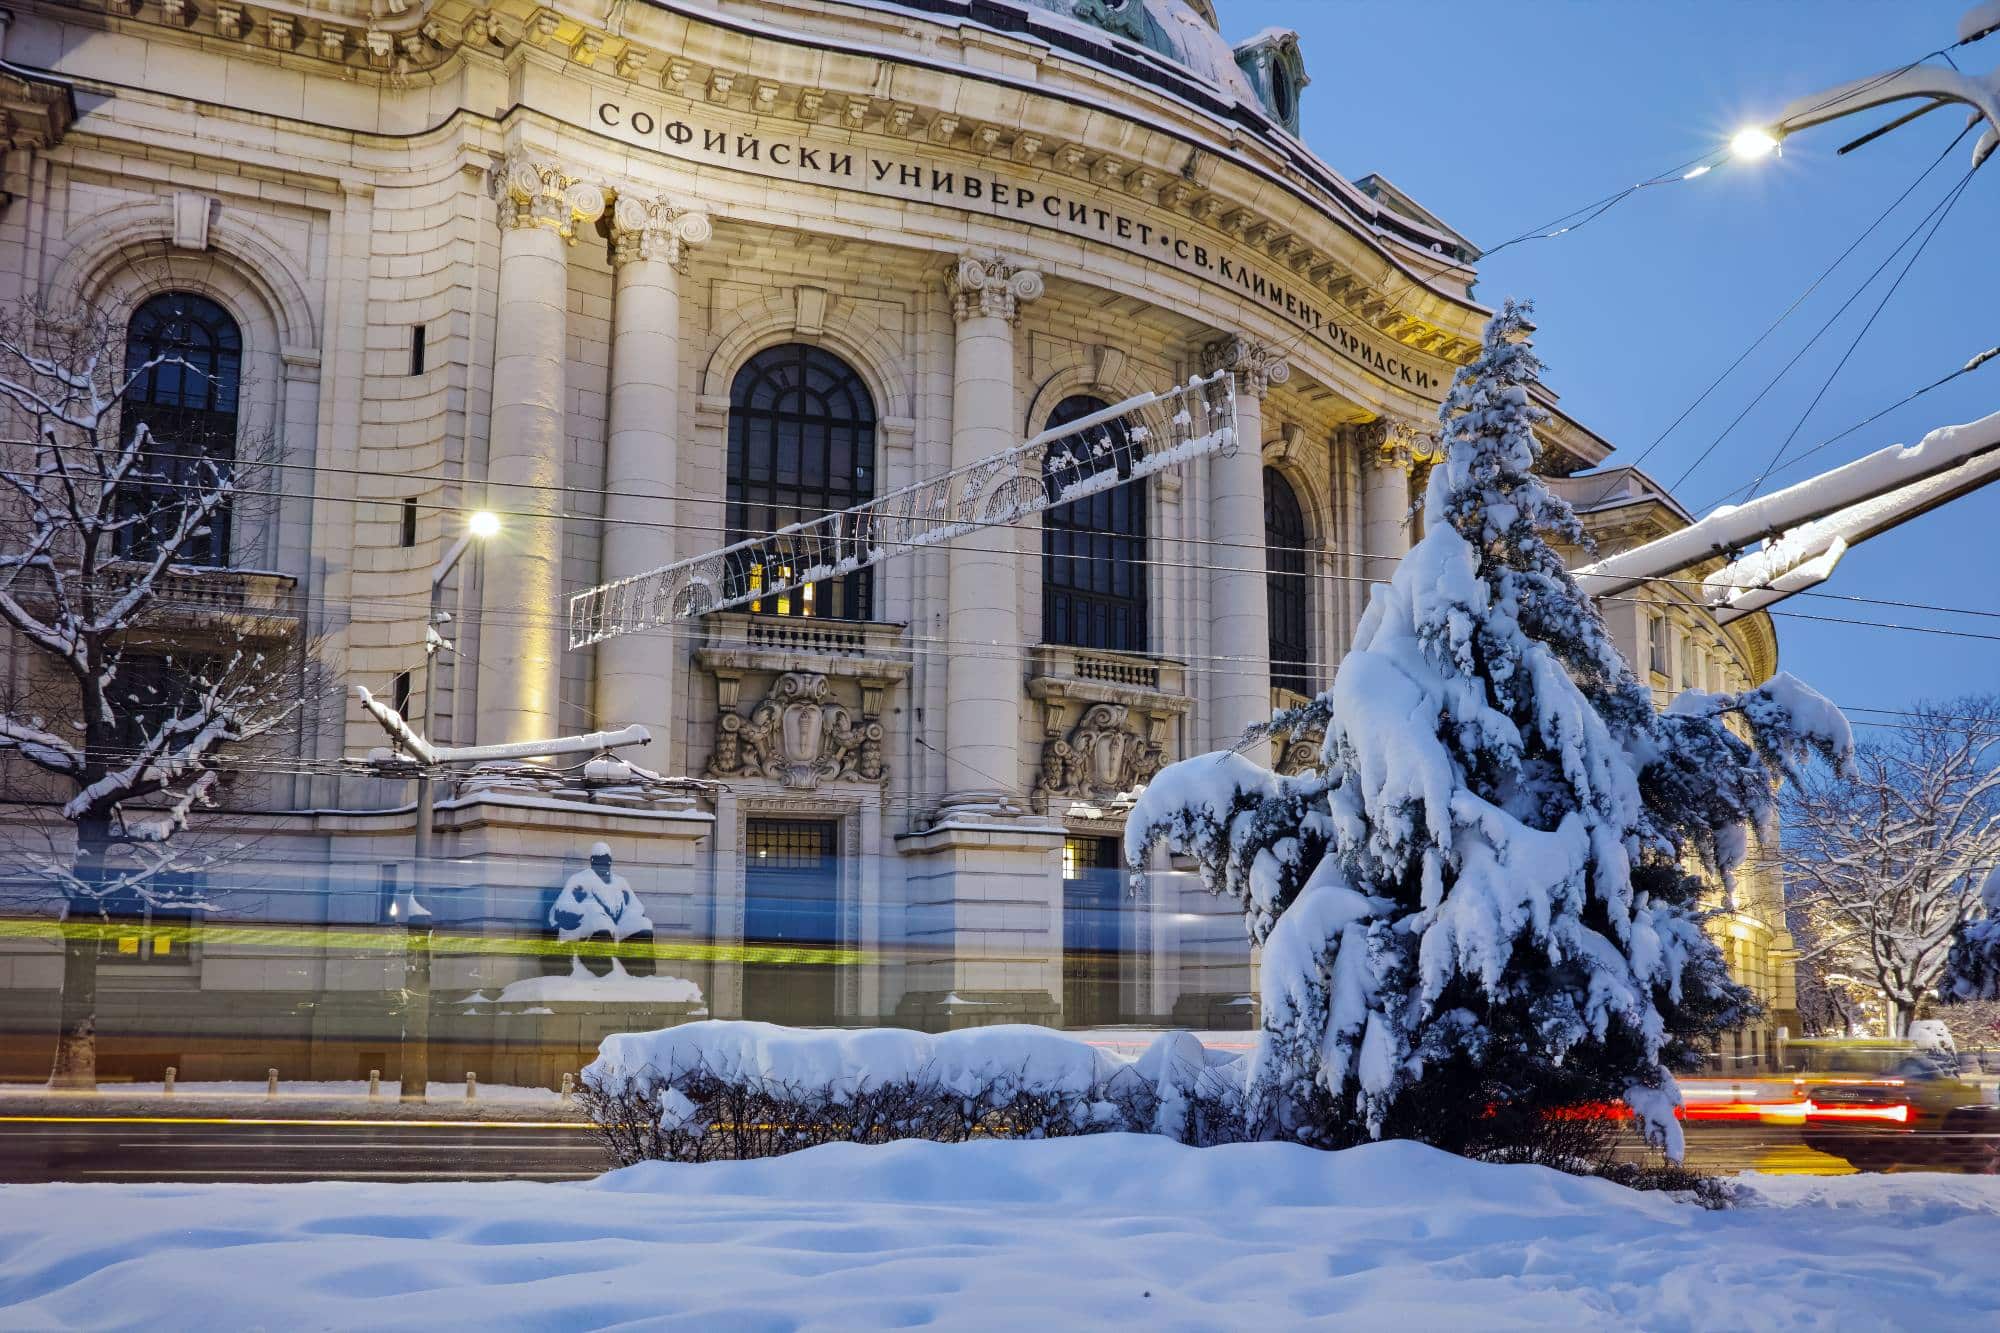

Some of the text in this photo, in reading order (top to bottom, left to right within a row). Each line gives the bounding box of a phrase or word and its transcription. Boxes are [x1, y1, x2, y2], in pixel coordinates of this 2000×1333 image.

[598, 103, 1428, 388] СОФИЙСКИ УНИВЕРСИТЕТ СВ. КЛИМЕНТ ОХРИДСКИ
